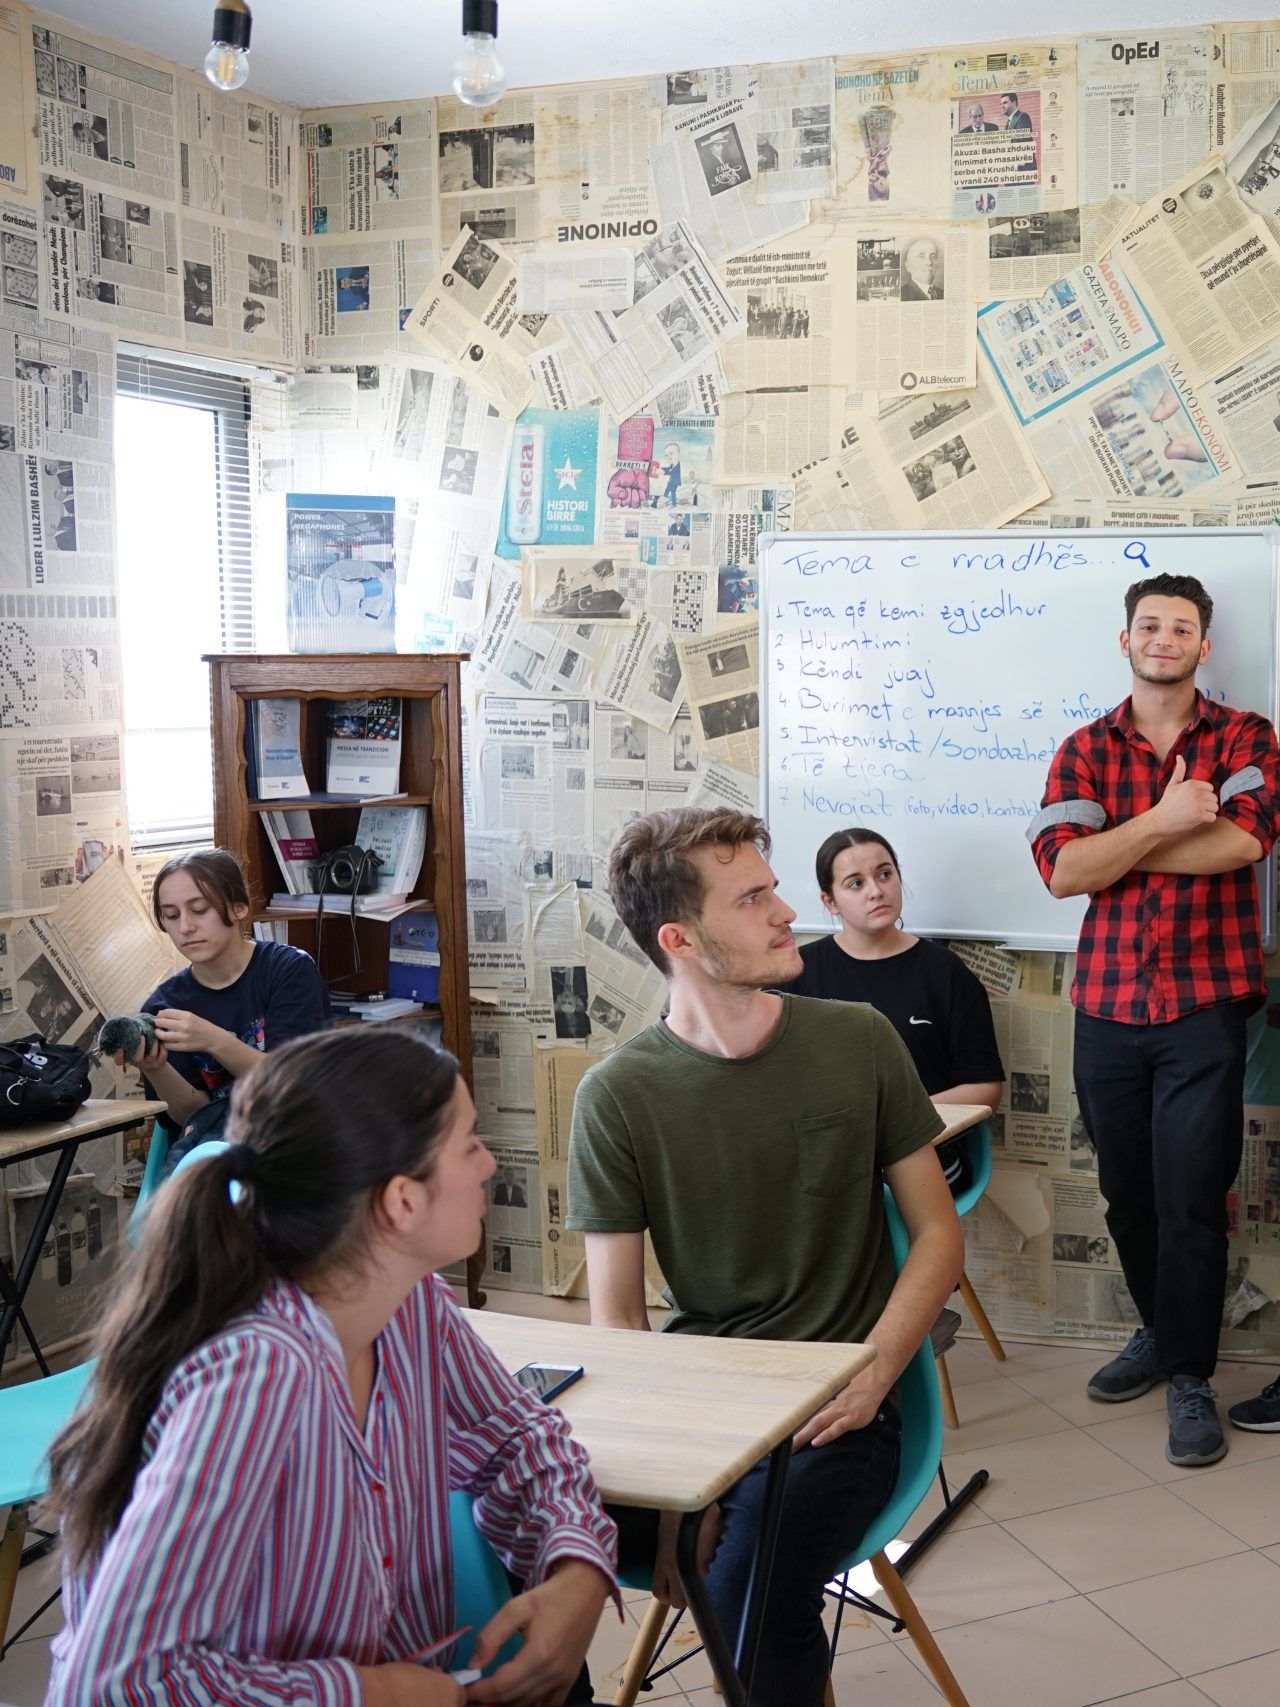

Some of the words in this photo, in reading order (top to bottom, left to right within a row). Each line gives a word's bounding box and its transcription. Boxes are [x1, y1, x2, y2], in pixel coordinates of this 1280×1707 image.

[1110, 40, 1160, 65] OpEd
[953, 147, 980, 157] Akuza:
[981, 145, 1006, 154] Basha
[1006, 142, 1036, 152] zhduku
[953, 155, 986, 166] filmimet
[993, 152, 1032, 163] masakrës
[953, 168, 974, 176] serbe
[975, 166, 985, 174] në
[960, 176, 981, 185] vranë
[983, 175, 999, 183] 240
[999, 171, 1038, 184] shqiptarë
[556, 218, 658, 242] OPINIONE
[1081, 263, 1109, 308] GAZETA
[1106, 311, 1132, 351] MAPO
[1167, 361, 1200, 410] MAPO
[1189, 405, 1232, 474] EKONOMI
[547, 500, 589, 512] HISTORI
[547, 511, 576, 522] BIRRE
[30, 499, 42, 541] LULZIM
[34, 550, 44, 584] LIDER
[784, 550, 873, 575] Tema
[788, 600, 835, 618] Tema
[879, 600, 925, 620] kemi
[940, 588, 1047, 634] zgjedhur
[1062, 692, 1113, 719] infor
